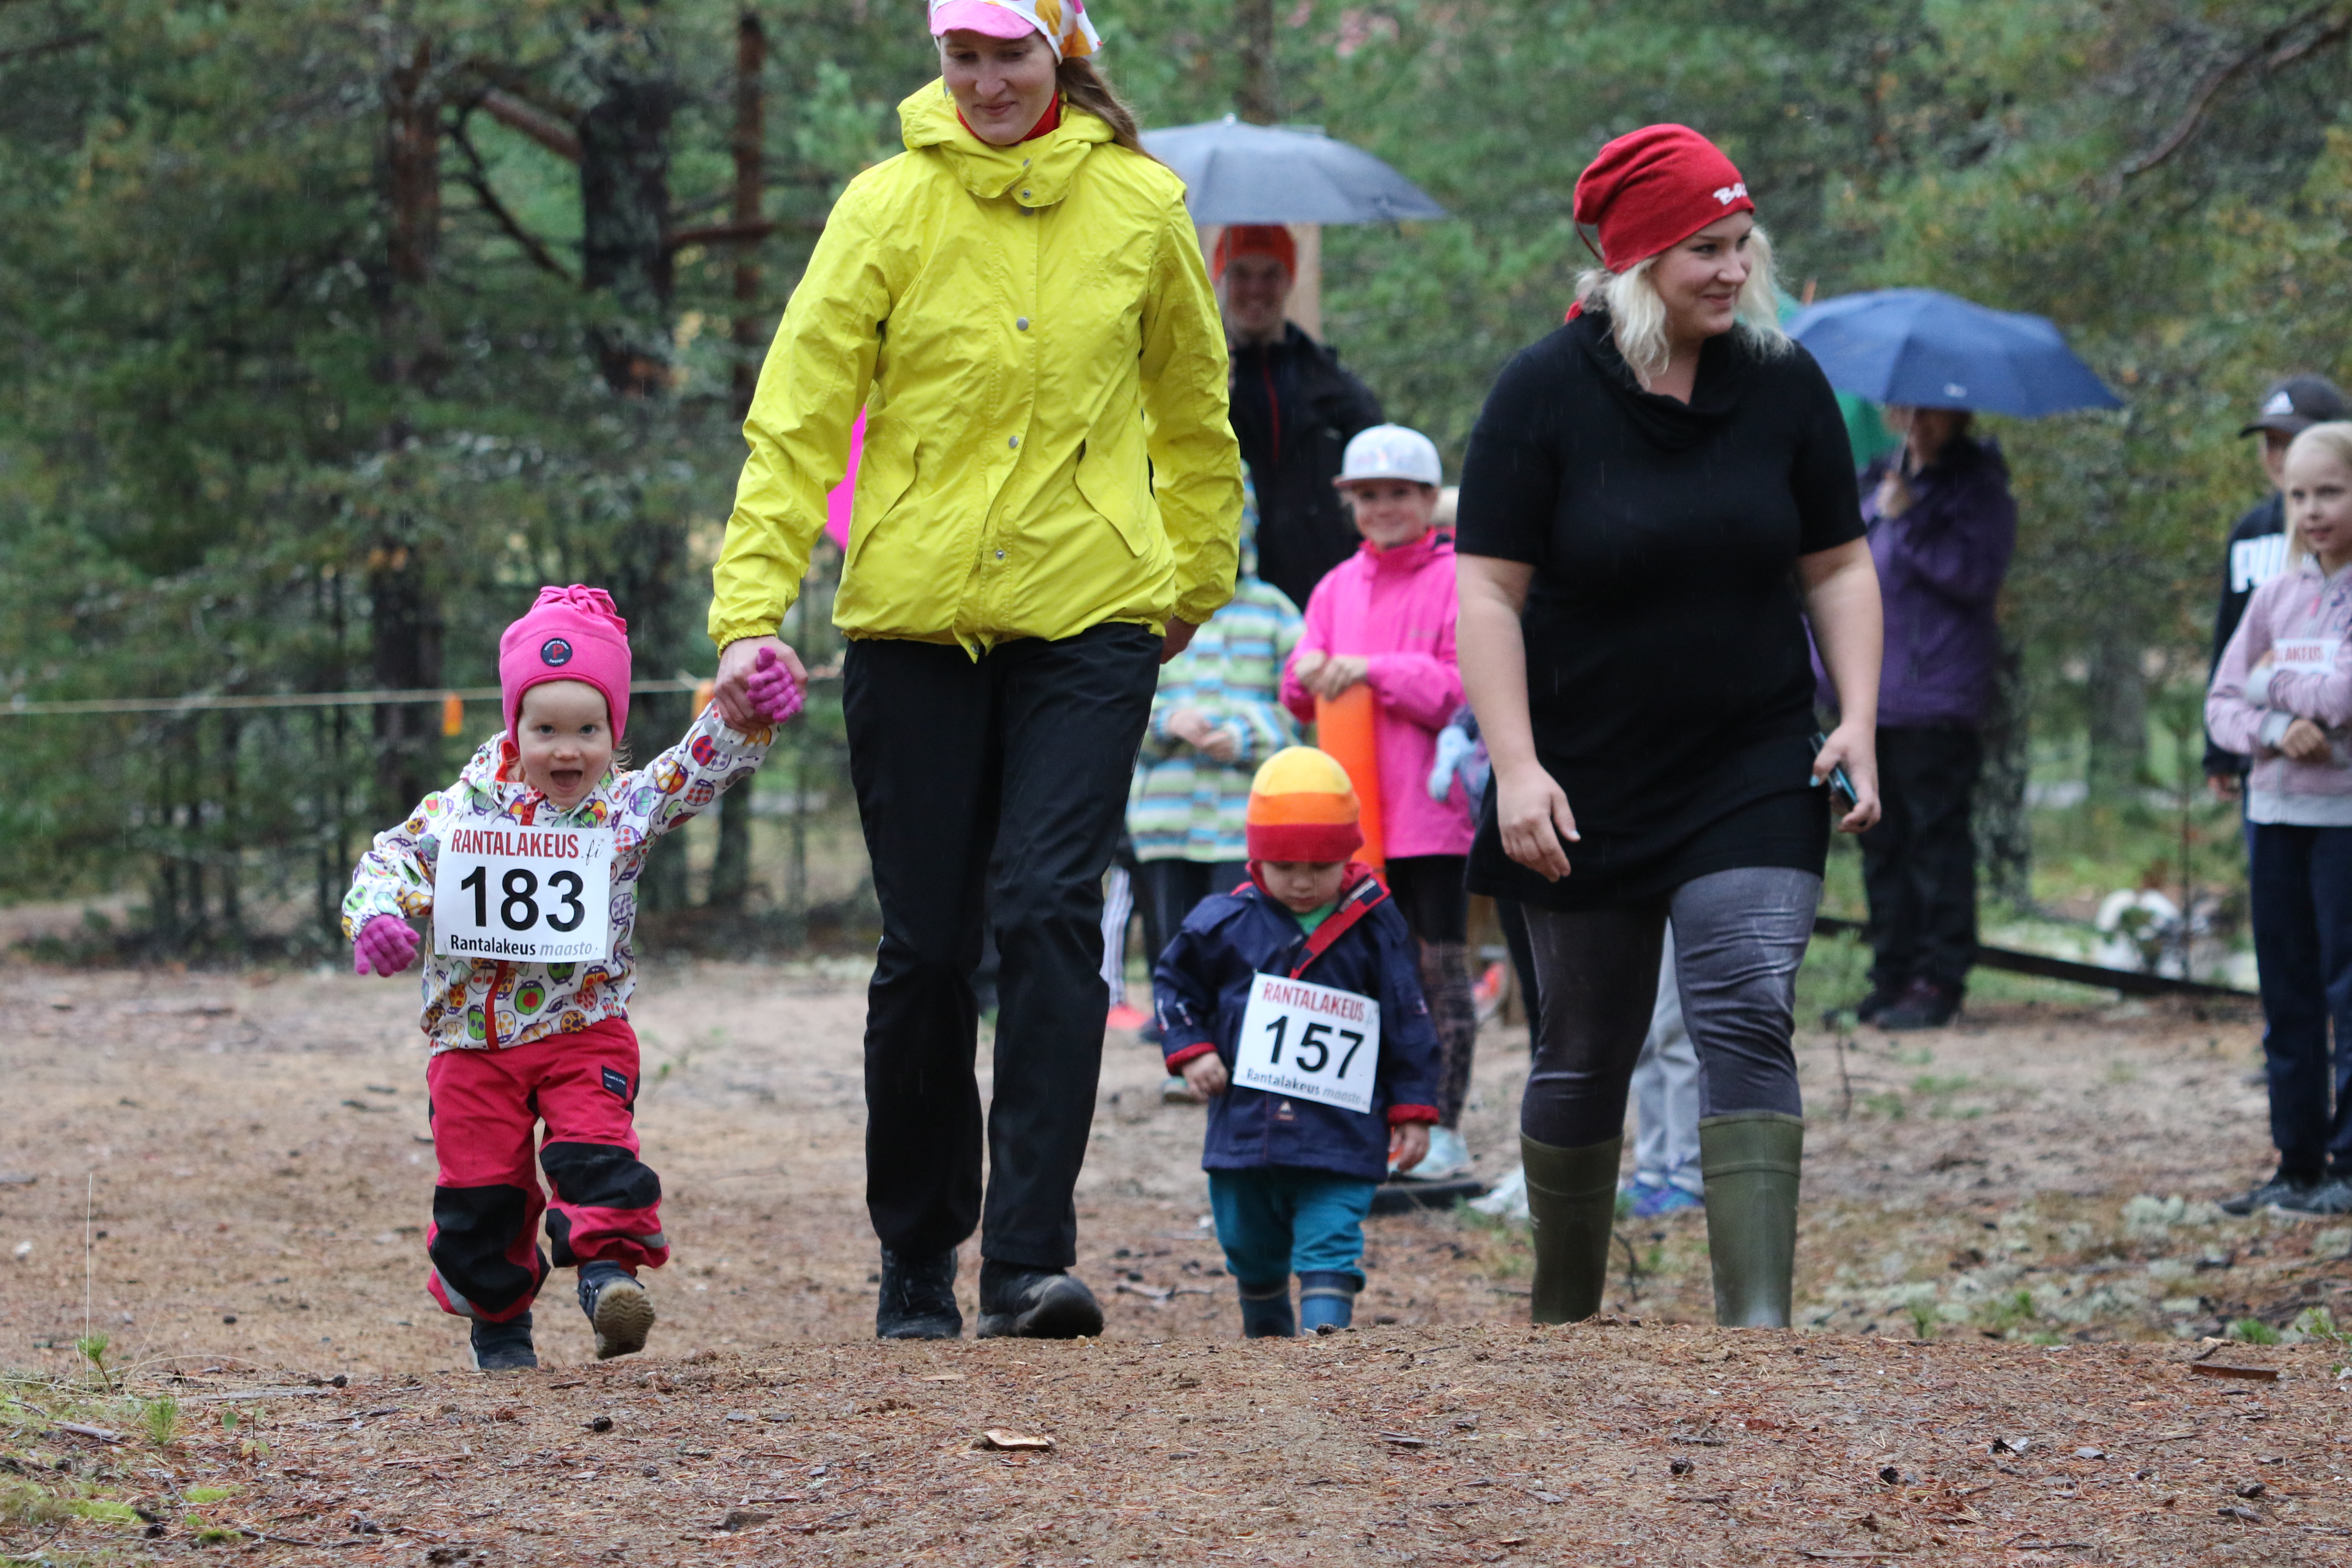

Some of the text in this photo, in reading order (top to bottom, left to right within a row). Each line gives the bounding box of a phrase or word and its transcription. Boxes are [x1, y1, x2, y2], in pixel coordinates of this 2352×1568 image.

[461, 866, 585, 932] 183
[451, 935, 592, 956] Rantalakeus maasto
[1265, 1015, 1364, 1079] 157
[1247, 1068, 1320, 1096] Rantalakeus
